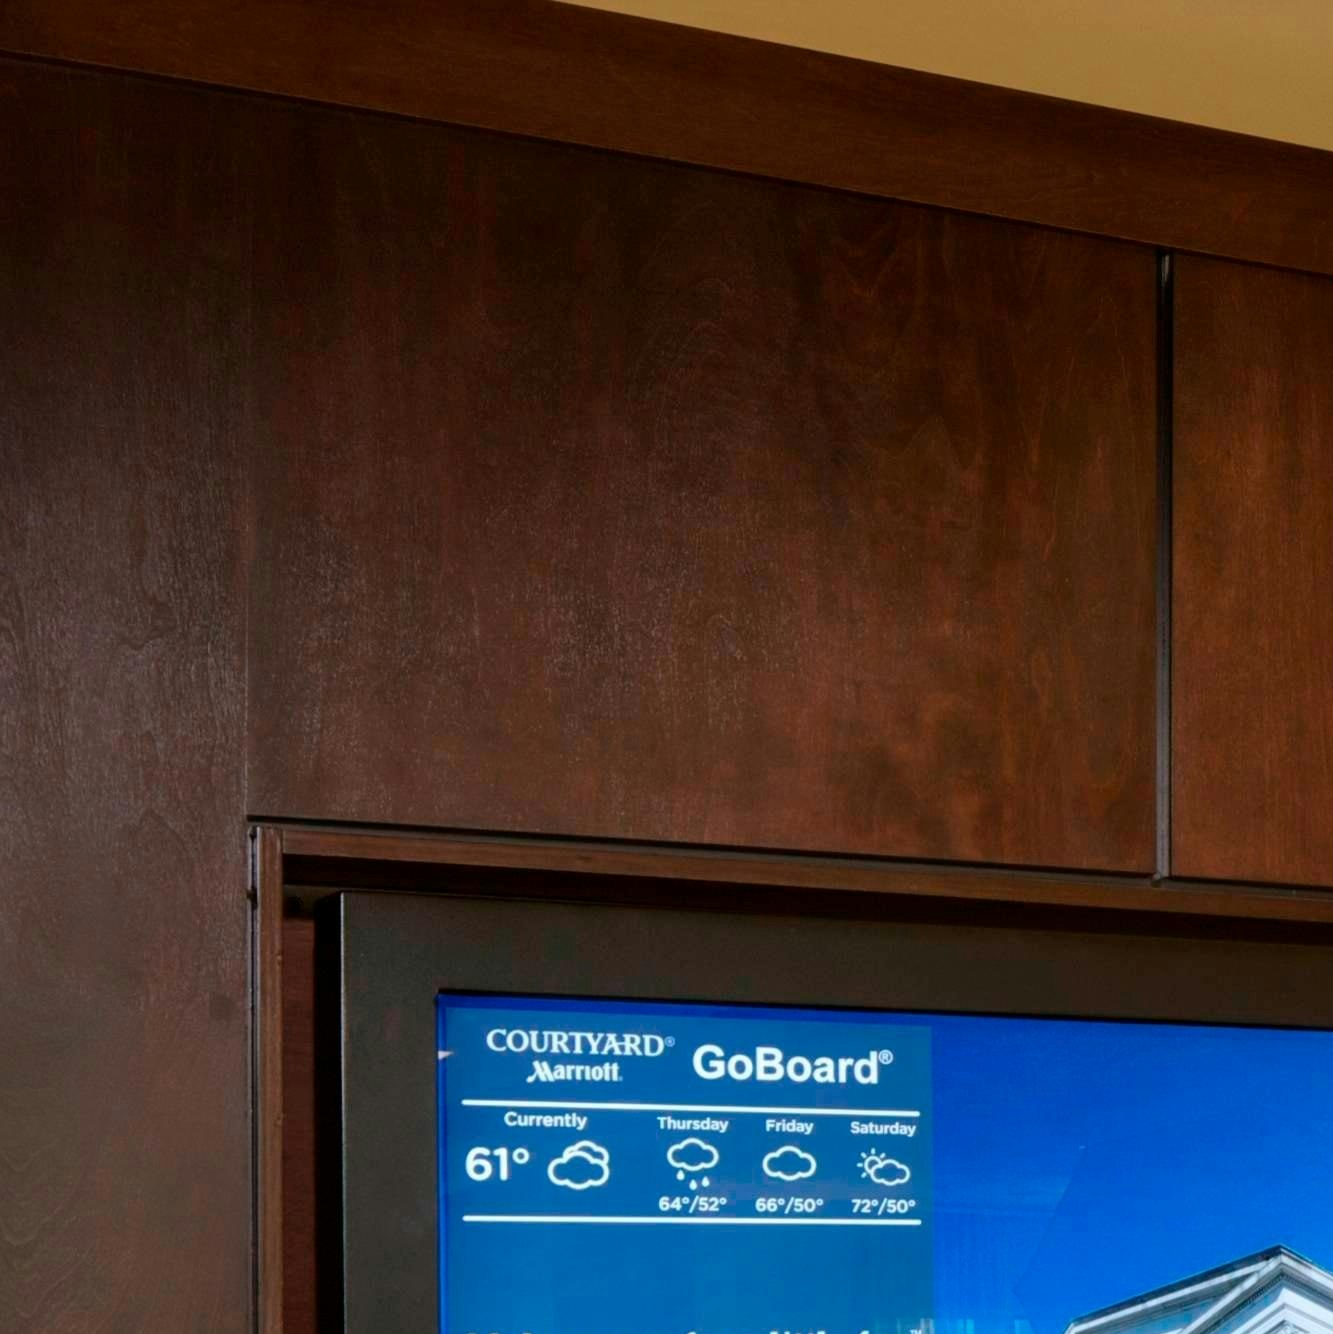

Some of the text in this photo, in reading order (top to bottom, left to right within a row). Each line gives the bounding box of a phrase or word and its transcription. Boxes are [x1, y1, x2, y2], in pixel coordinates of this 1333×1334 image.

[504, 1111, 588, 1131] Currently
[657, 1116, 729, 1133] Thursday
[765, 1118, 814, 1135] Friday
[850, 1121, 917, 1137] Saturday
[464, 1146, 530, 1181] 61°
[658, 1196, 727, 1214] 64°/52°
[755, 1197, 824, 1214] 66°/50°
[851, 1198, 916, 1216] 72°/50°
